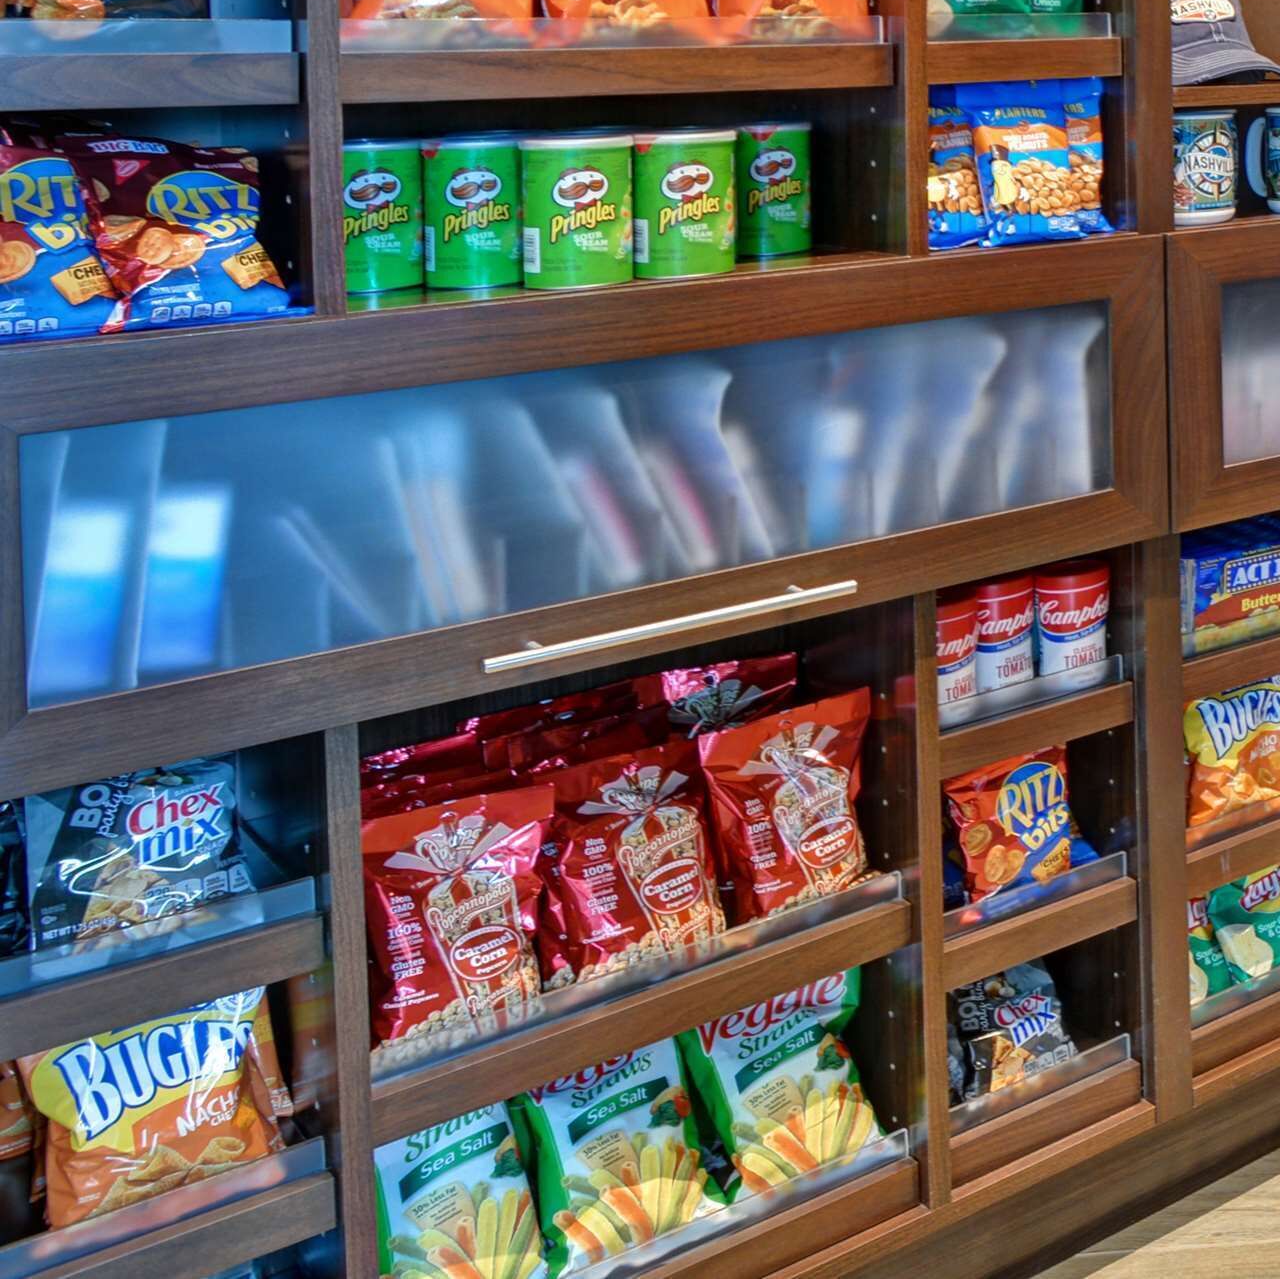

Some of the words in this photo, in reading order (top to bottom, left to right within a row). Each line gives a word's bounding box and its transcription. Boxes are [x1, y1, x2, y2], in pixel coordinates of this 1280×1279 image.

[148, 183, 259, 225] RITZ
[659, 192, 720, 235] Pringles
[749, 179, 801, 214] Pringles
[444, 201, 510, 242] Pringles
[551, 201, 615, 244] Pringles
[1233, 561, 1277, 588] ACT
[127, 783, 225, 838] Chex
[1000, 765, 1058, 837] RITZ
[139, 808, 225, 866] mix
[586, 838, 604, 846] Non
[801, 821, 853, 852] Caramel
[1021, 803, 1068, 850] bits
[815, 838, 846, 857] Corn
[644, 866, 698, 896] Caramel
[659, 884, 693, 902] Corn
[587, 895, 618, 908] Gluten
[1257, 919, 1274, 934] Sour
[454, 933, 514, 960] Caramel
[470, 946, 507, 967] Corn
[392, 958, 426, 971] Gluten
[394, 966, 424, 980] FREE
[996, 993, 1046, 1027] Chex
[736, 1007, 819, 1060] Straws
[751, 1051, 782, 1074] Sea
[784, 1031, 816, 1058] Salt
[586, 1103, 617, 1125] Sea
[618, 1087, 648, 1110] Salt
[419, 1149, 458, 1180] Sea
[459, 1132, 495, 1160] Salt
